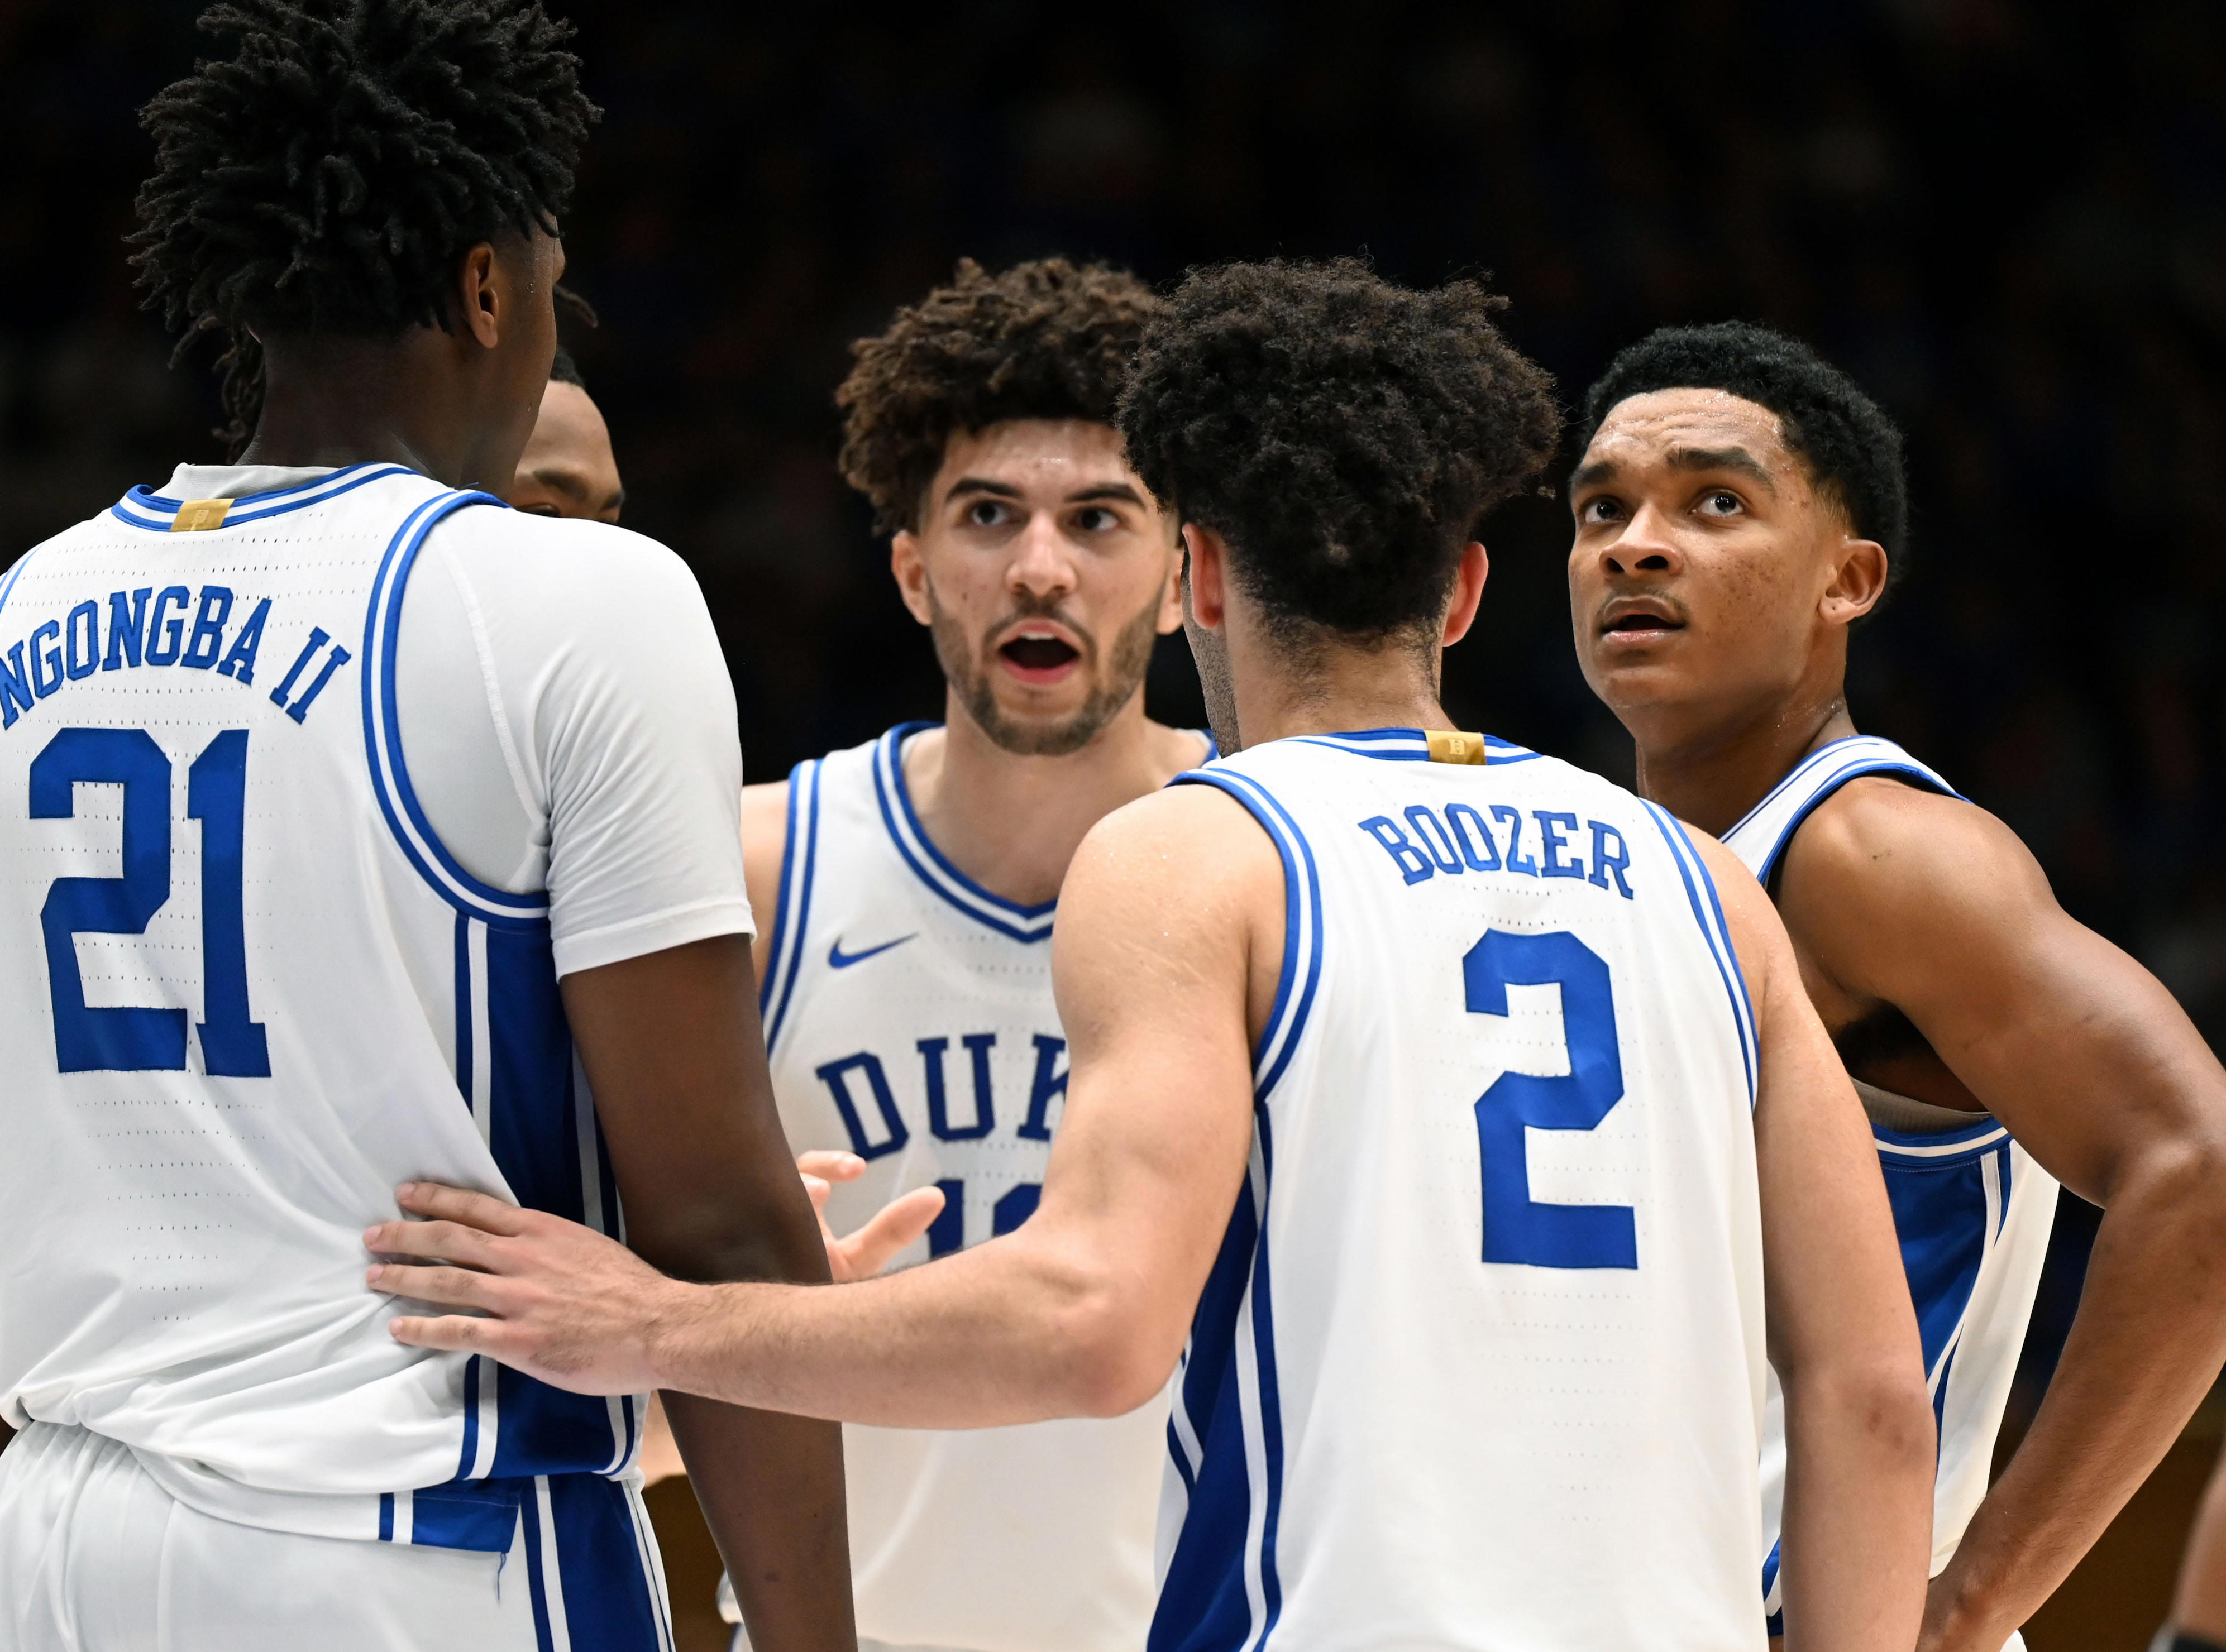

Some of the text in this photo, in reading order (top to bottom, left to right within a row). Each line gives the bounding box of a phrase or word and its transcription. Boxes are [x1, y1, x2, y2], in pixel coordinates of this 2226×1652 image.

[0, 585, 351, 730] NGONGBA II
[29, 727, 272, 1078] 21
[1358, 803, 1633, 900] BOOZER
[815, 1033, 1071, 1163] DUK
[1462, 927, 1638, 1270] 2
